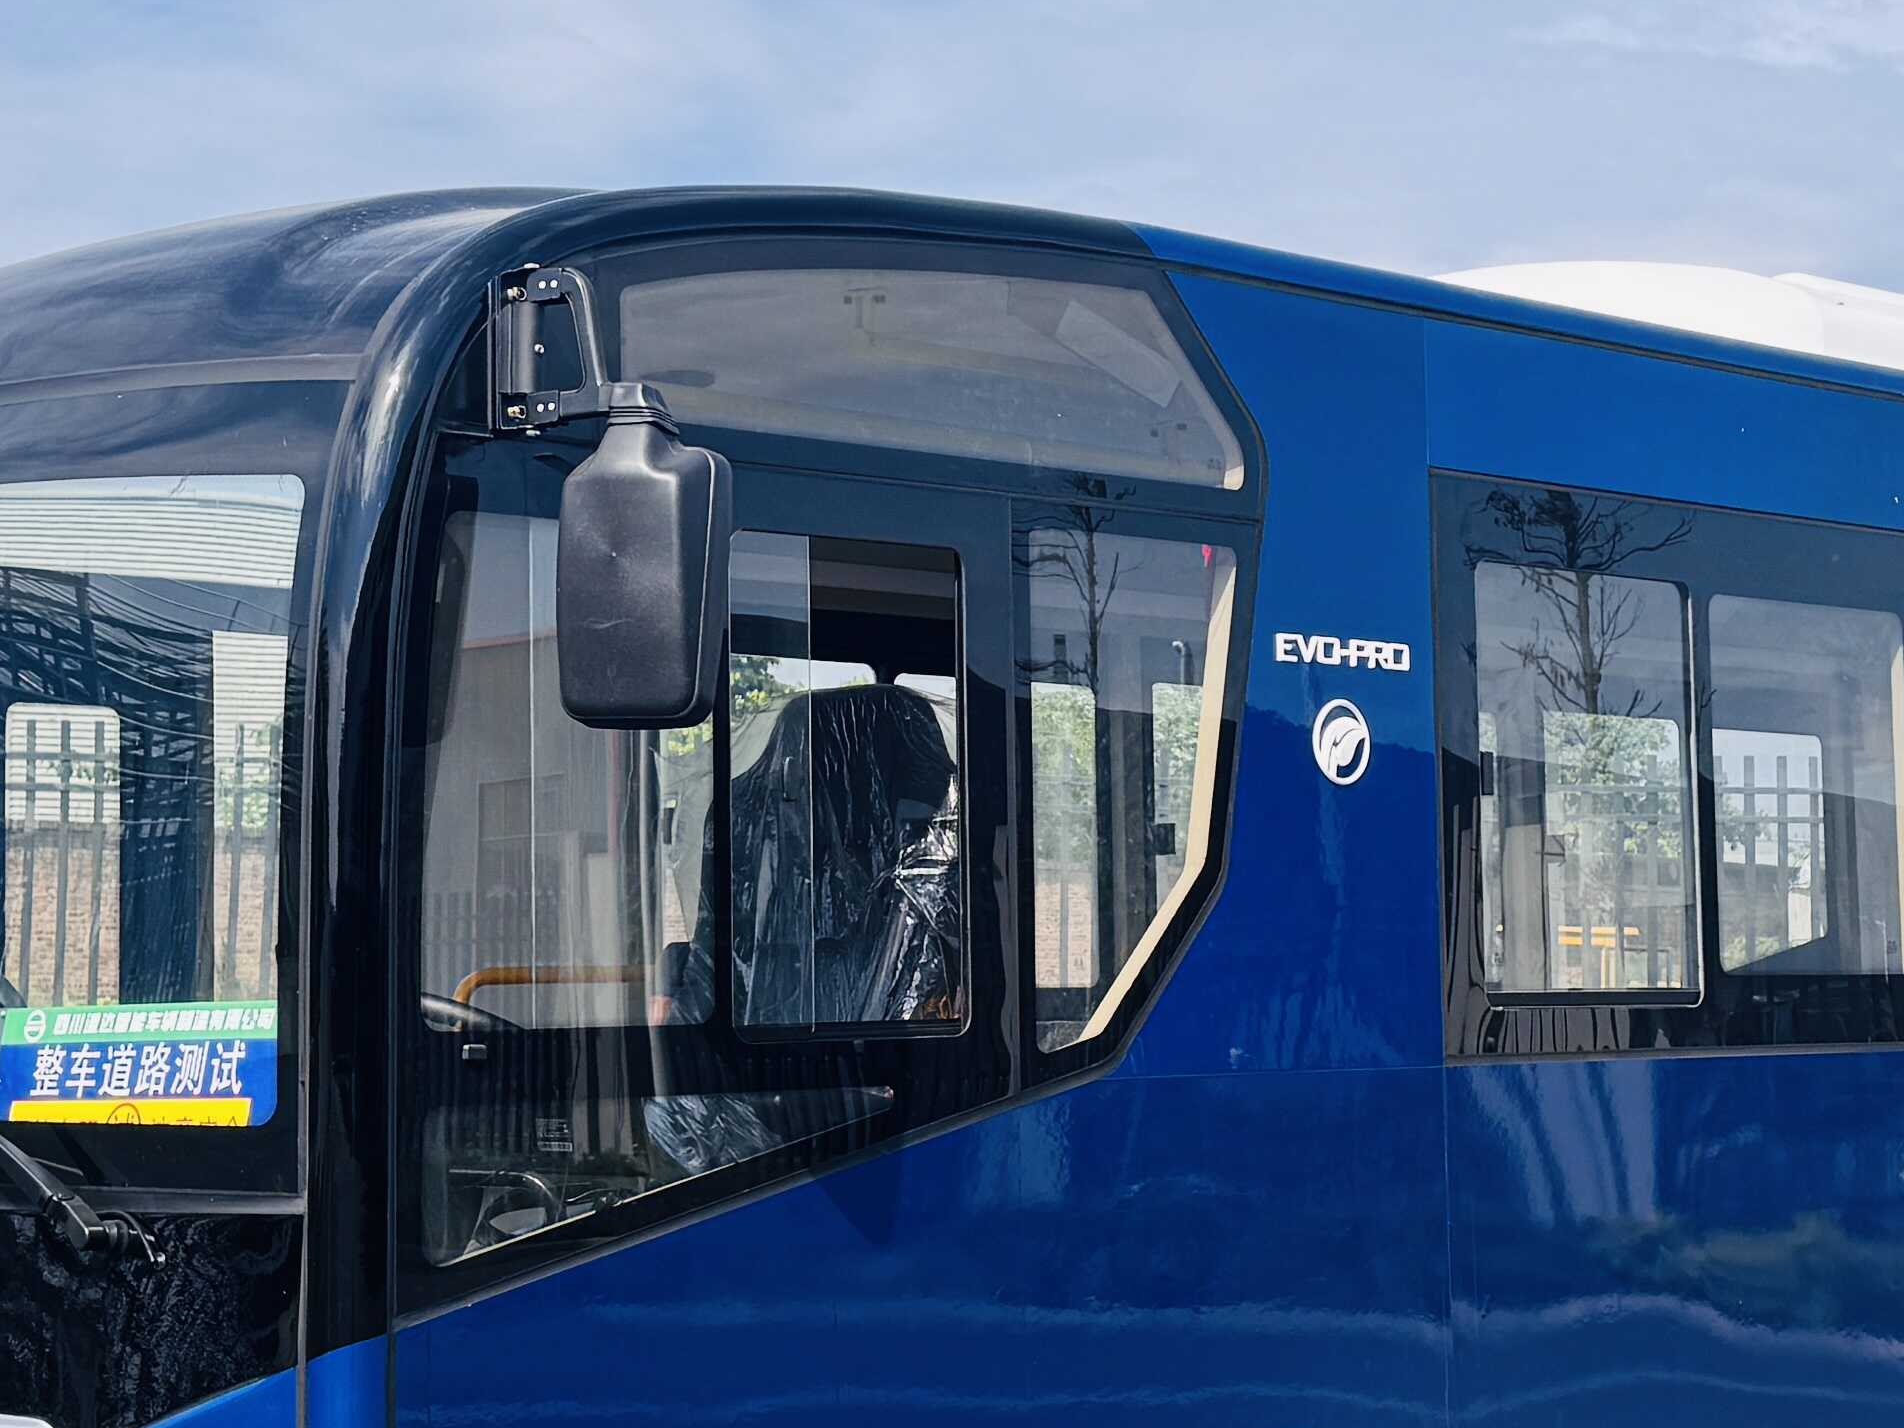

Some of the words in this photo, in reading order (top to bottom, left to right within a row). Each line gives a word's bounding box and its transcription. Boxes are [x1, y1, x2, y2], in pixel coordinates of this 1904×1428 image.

[1275, 632, 1411, 672] EVO-PRO
[29, 1039, 246, 1099] 整车道路测试
